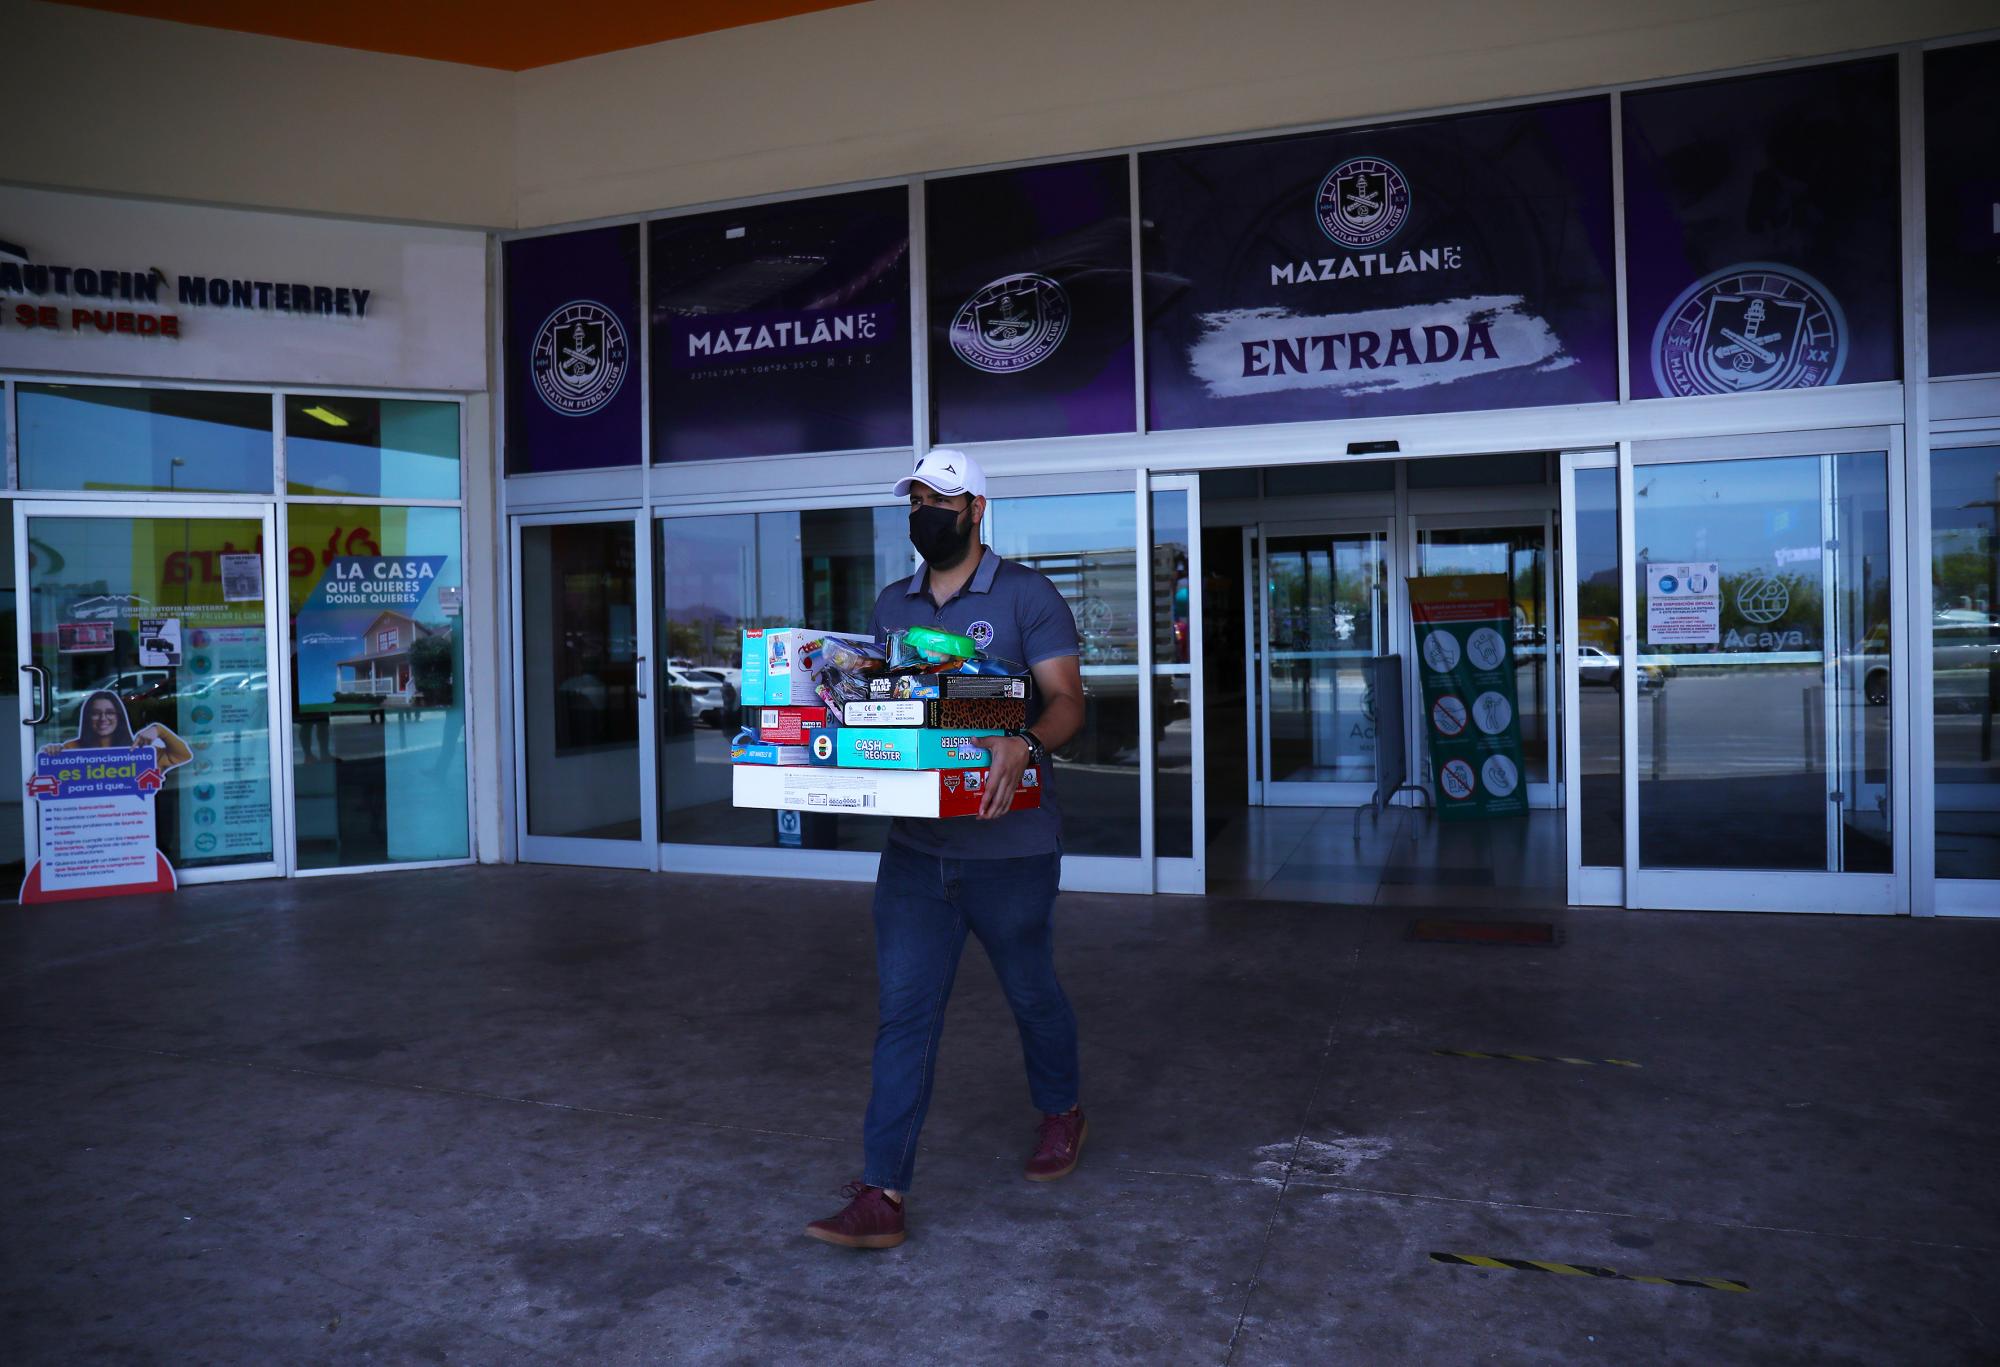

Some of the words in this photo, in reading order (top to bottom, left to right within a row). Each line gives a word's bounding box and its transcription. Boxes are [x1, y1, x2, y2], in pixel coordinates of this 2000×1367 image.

[1389, 207, 1403, 228] CLUB
[178, 275, 371, 318] MONTERREY
[15, 304, 58, 327] SE
[71, 308, 179, 338] PUEDE
[1240, 322, 1500, 378] ENTRADA
[1806, 347, 1830, 364] XX
[605, 365, 621, 391] CLUB
[336, 561, 365, 580] LA
[373, 561, 435, 580] CASA
[325, 581, 356, 594] QUE
[361, 580, 420, 594] QUIERES
[325, 593, 367, 604] DONDE
[369, 593, 419, 604] QUIERES.
[871, 678, 892, 686] STAR
[855, 739, 882, 751] CASH
[39, 757, 50, 767] El
[50, 753, 153, 766] autofinanciamiento
[864, 750, 901, 761] REGISTER
[58, 768, 82, 781] es
[86, 762, 137, 780] ideal
[67, 784, 95, 795] para
